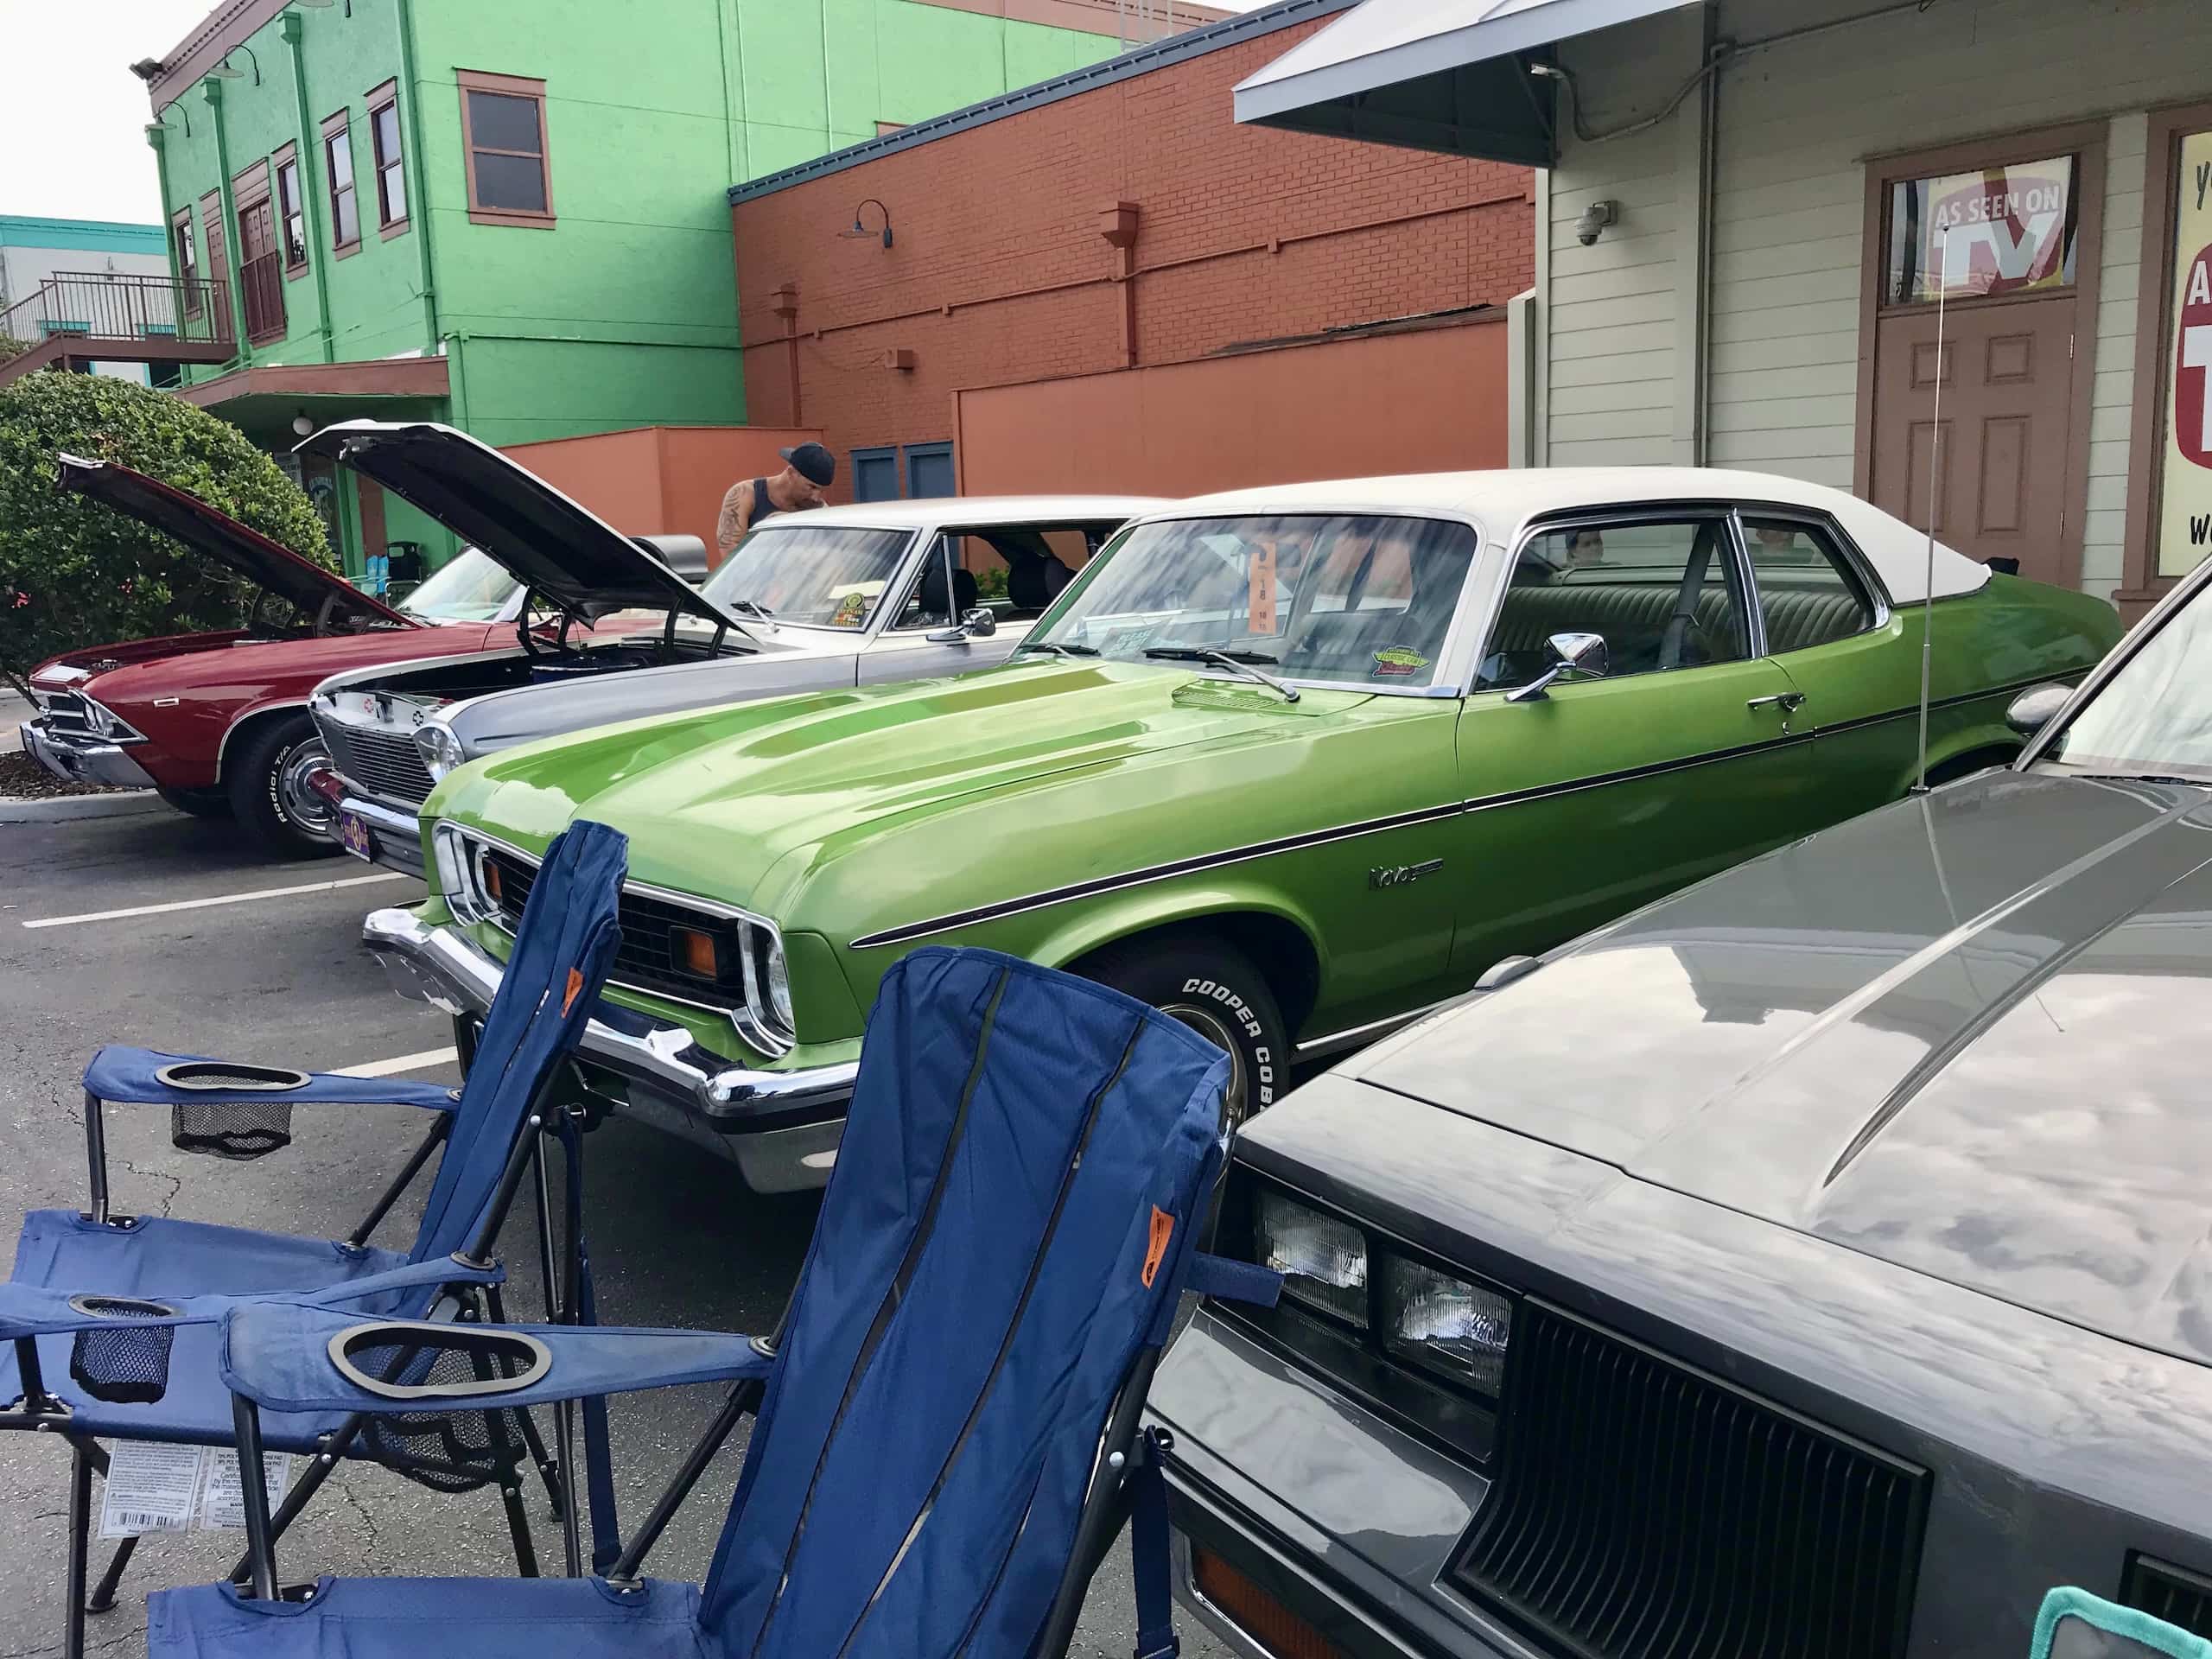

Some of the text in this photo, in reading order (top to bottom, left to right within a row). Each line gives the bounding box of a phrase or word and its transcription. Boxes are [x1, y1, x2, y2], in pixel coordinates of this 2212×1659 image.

[1936, 184, 2060, 229] AS SEEN ON
[2196, 161, 2212, 210] Y
[1933, 211, 2059, 287] TV
[2187, 260, 2212, 306] A
[2190, 513, 2212, 545] W
[1182, 978, 1263, 1039] COOPER
